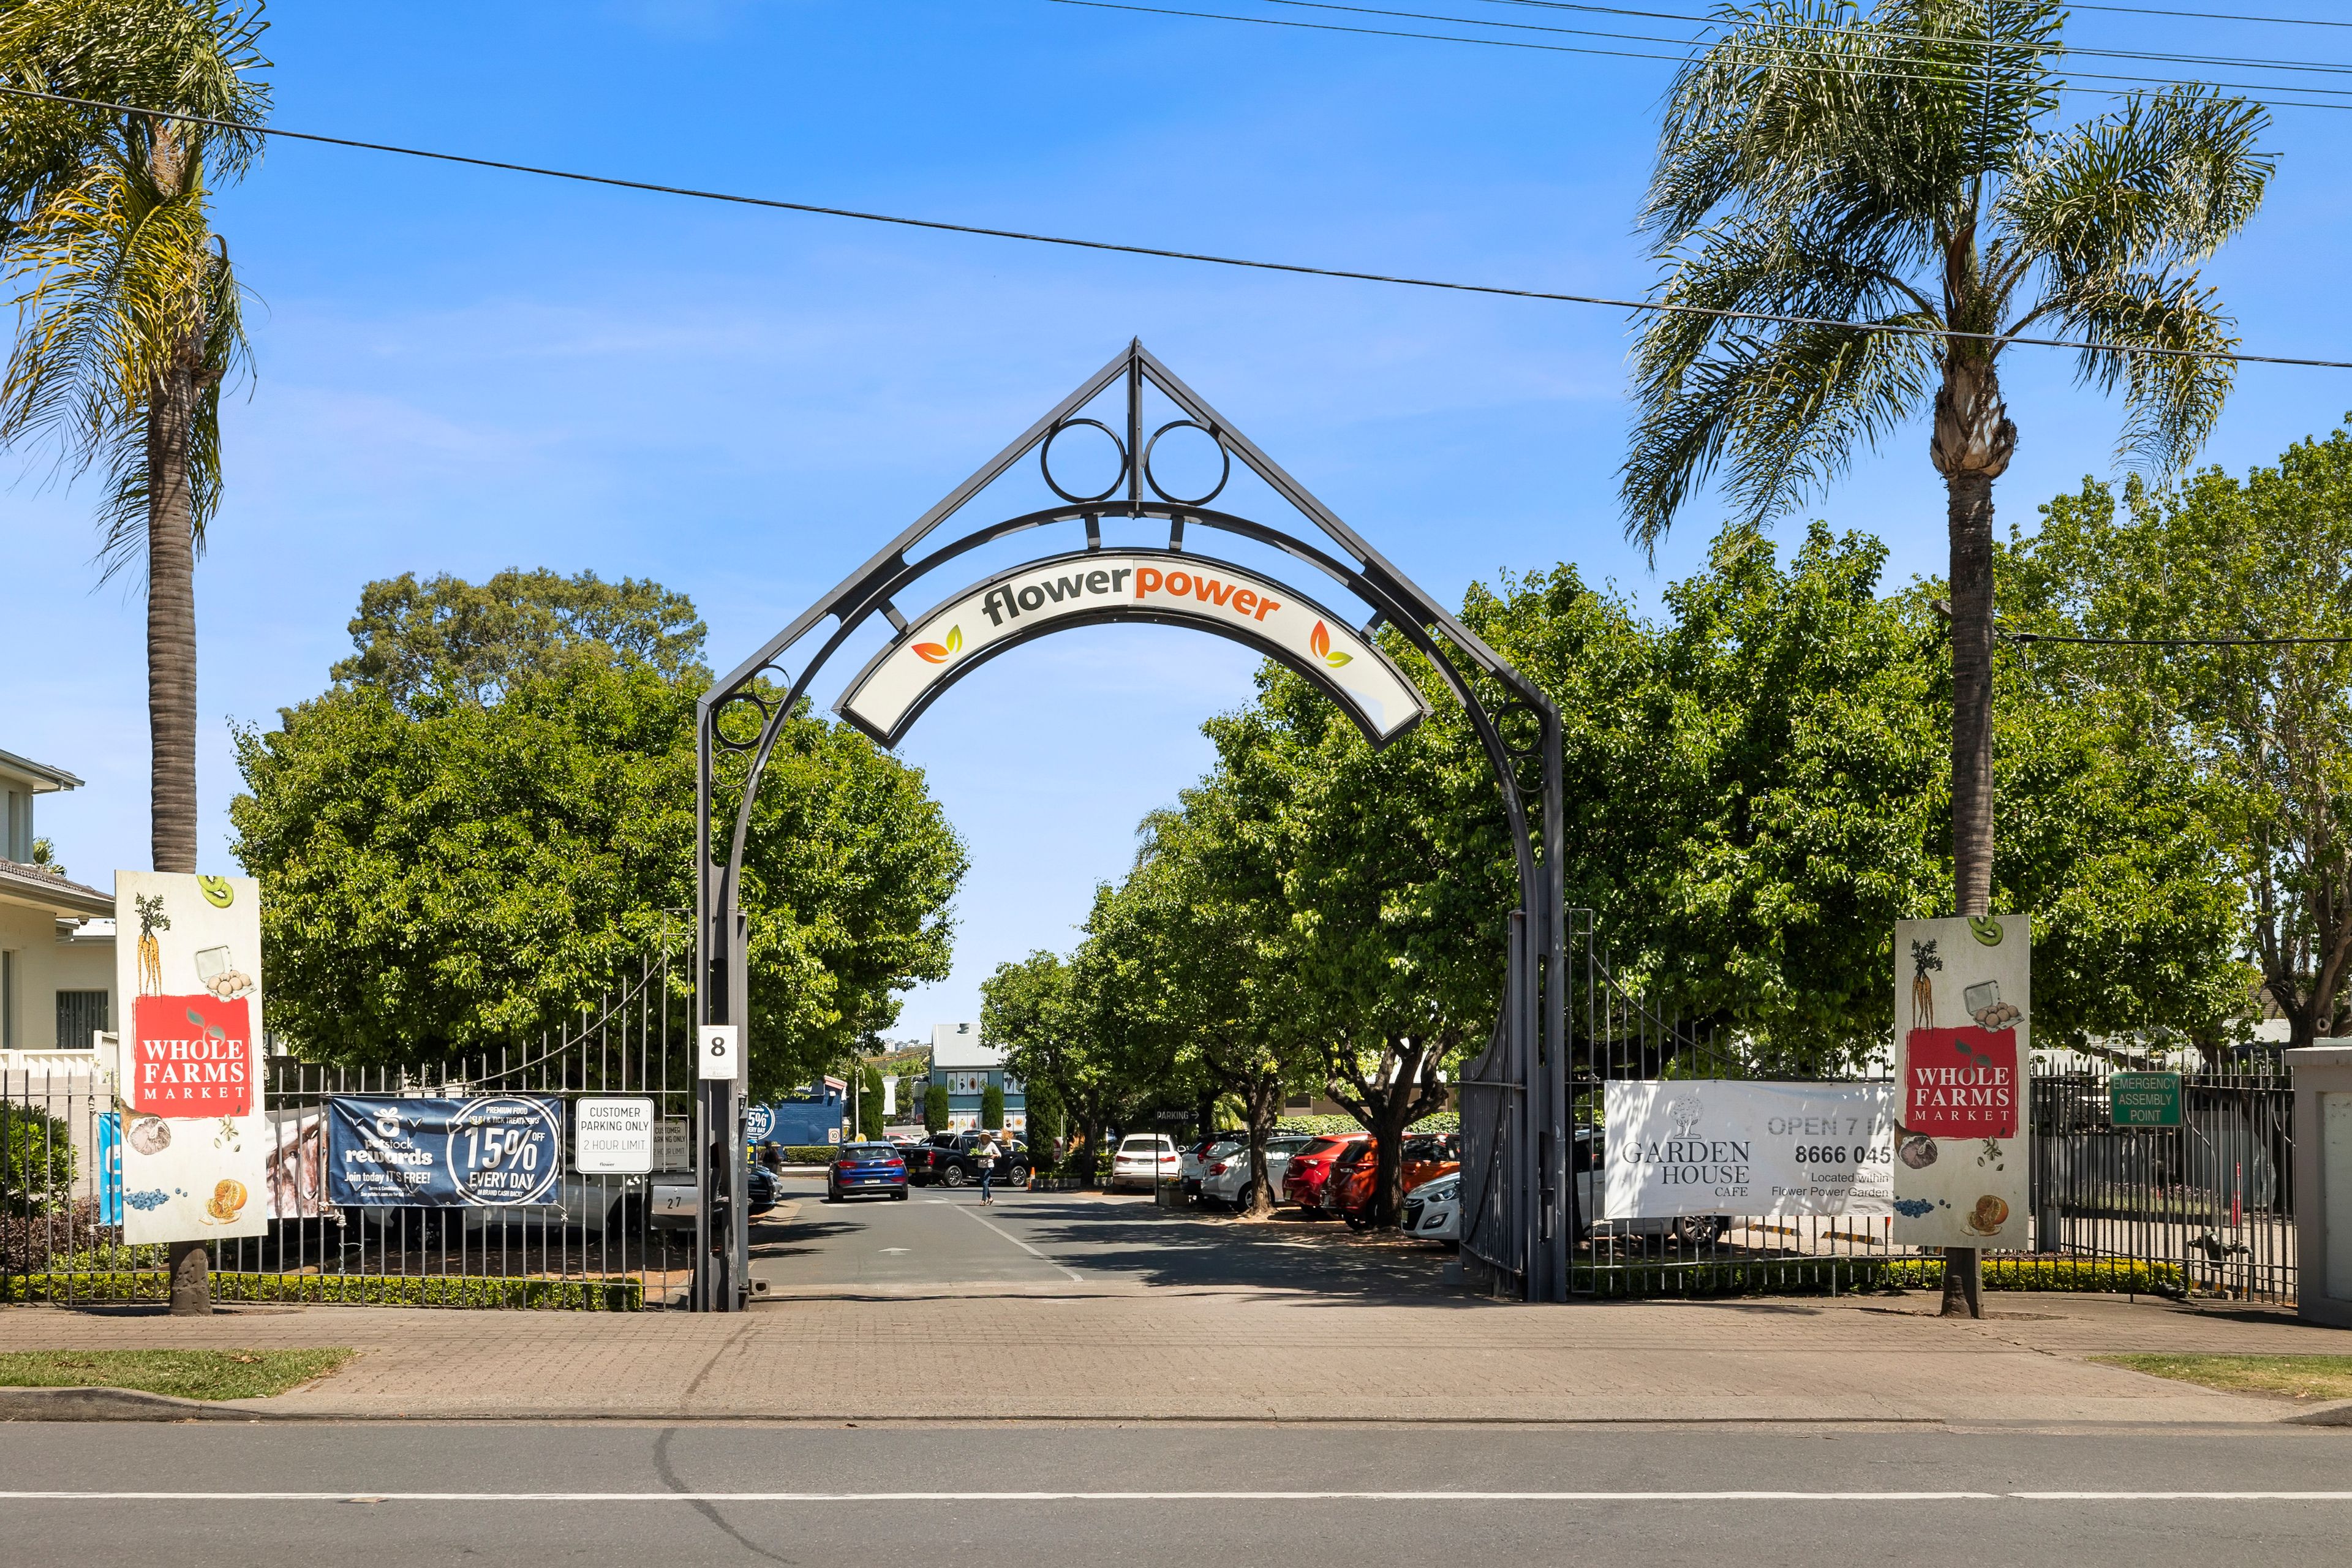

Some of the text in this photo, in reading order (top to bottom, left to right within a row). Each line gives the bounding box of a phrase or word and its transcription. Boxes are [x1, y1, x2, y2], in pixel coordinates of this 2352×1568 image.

[143, 1039, 244, 1061] WHOLE
[711, 1037, 725, 1056] 8
[143, 1062, 245, 1084] FARMS
[1915, 1067, 2010, 1087] WHOLE
[2114, 1077, 2177, 1090] EMERGENCY
[144, 1087, 244, 1099] MARKET
[1915, 1088, 2010, 1107] FARMS
[2118, 1094, 2173, 1106] ASSEMBLY
[486, 1106, 513, 1115] PREMIUM
[590, 1107, 640, 1117] CUSTOMER
[1156, 1111, 1189, 1120] PARKING
[1915, 1110, 2010, 1121] MARKET
[2130, 1110, 2162, 1122] POINT
[581, 1121, 649, 1131] PARKING ONLY
[748, 1112, 767, 1128] 5%
[1768, 1117, 1837, 1135] OPEN
[1845, 1117, 1858, 1135] 7
[364, 1137, 413, 1150] petstock
[532, 1132, 545, 1142] OFF
[464, 1127, 538, 1171] 15%
[584, 1140, 646, 1150] 2 HOUR LIMIT
[345, 1148, 433, 1166] rewards
[1623, 1141, 1751, 1163] GARDEN
[1795, 1146, 1894, 1164] 8666 045
[344, 1170, 431, 1184] Join today IT'S FREE!
[469, 1171, 535, 1190] EVERY DAY
[1662, 1166, 1750, 1185] HOUSE
[1811, 1172, 1889, 1183] Located within
[1714, 1186, 1748, 1197] CAFE
[1772, 1186, 1888, 1197] Flower Power Garden
[668, 1196, 681, 1209] 27
